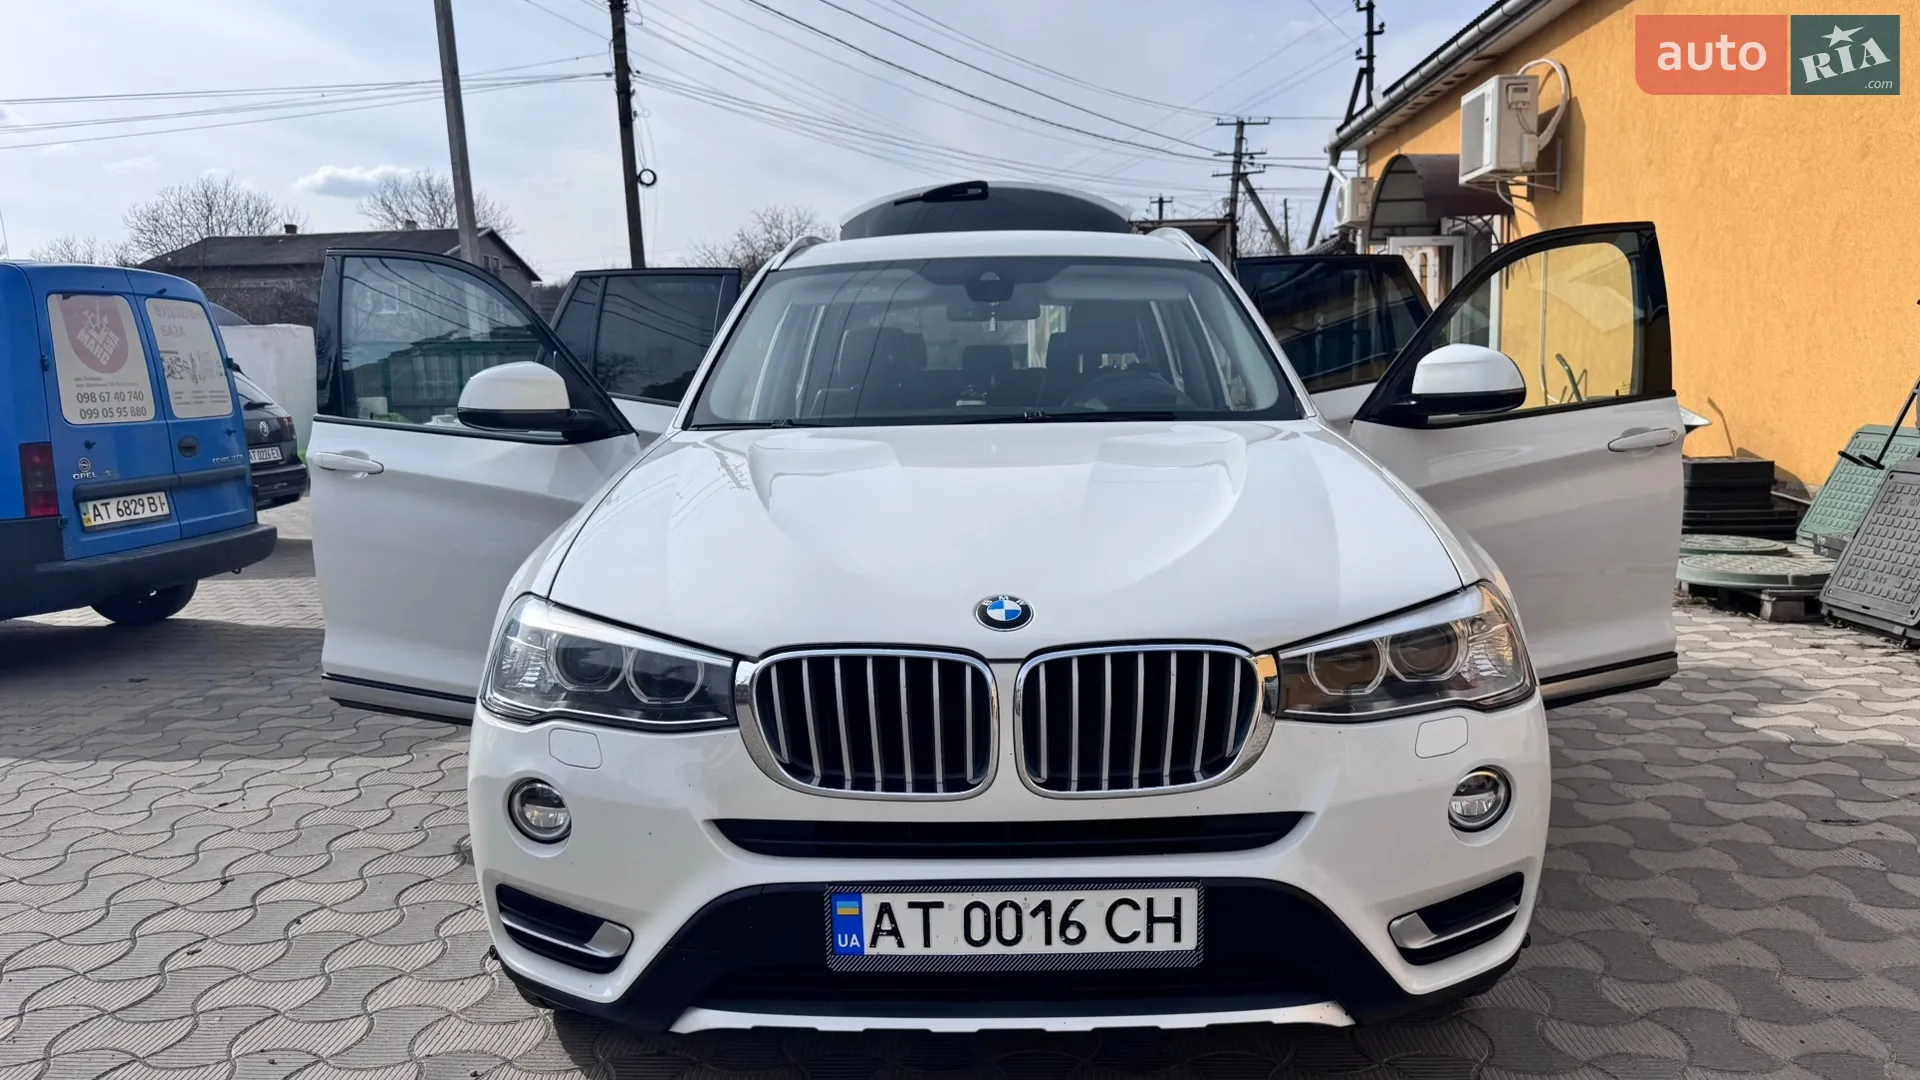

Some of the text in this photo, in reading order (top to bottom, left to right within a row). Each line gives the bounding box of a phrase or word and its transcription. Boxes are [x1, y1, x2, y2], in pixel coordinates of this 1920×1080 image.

[76, 390, 144, 404] 098 67 40 740
[79, 406, 147, 420] 099 05 95 880
[72, 472, 98, 480] OPEL
[92, 502, 111, 522] AT
[116, 498, 145, 517] 6829
[869, 896, 1182, 949] AT 0016 CH
[837, 933, 861, 949] UA
